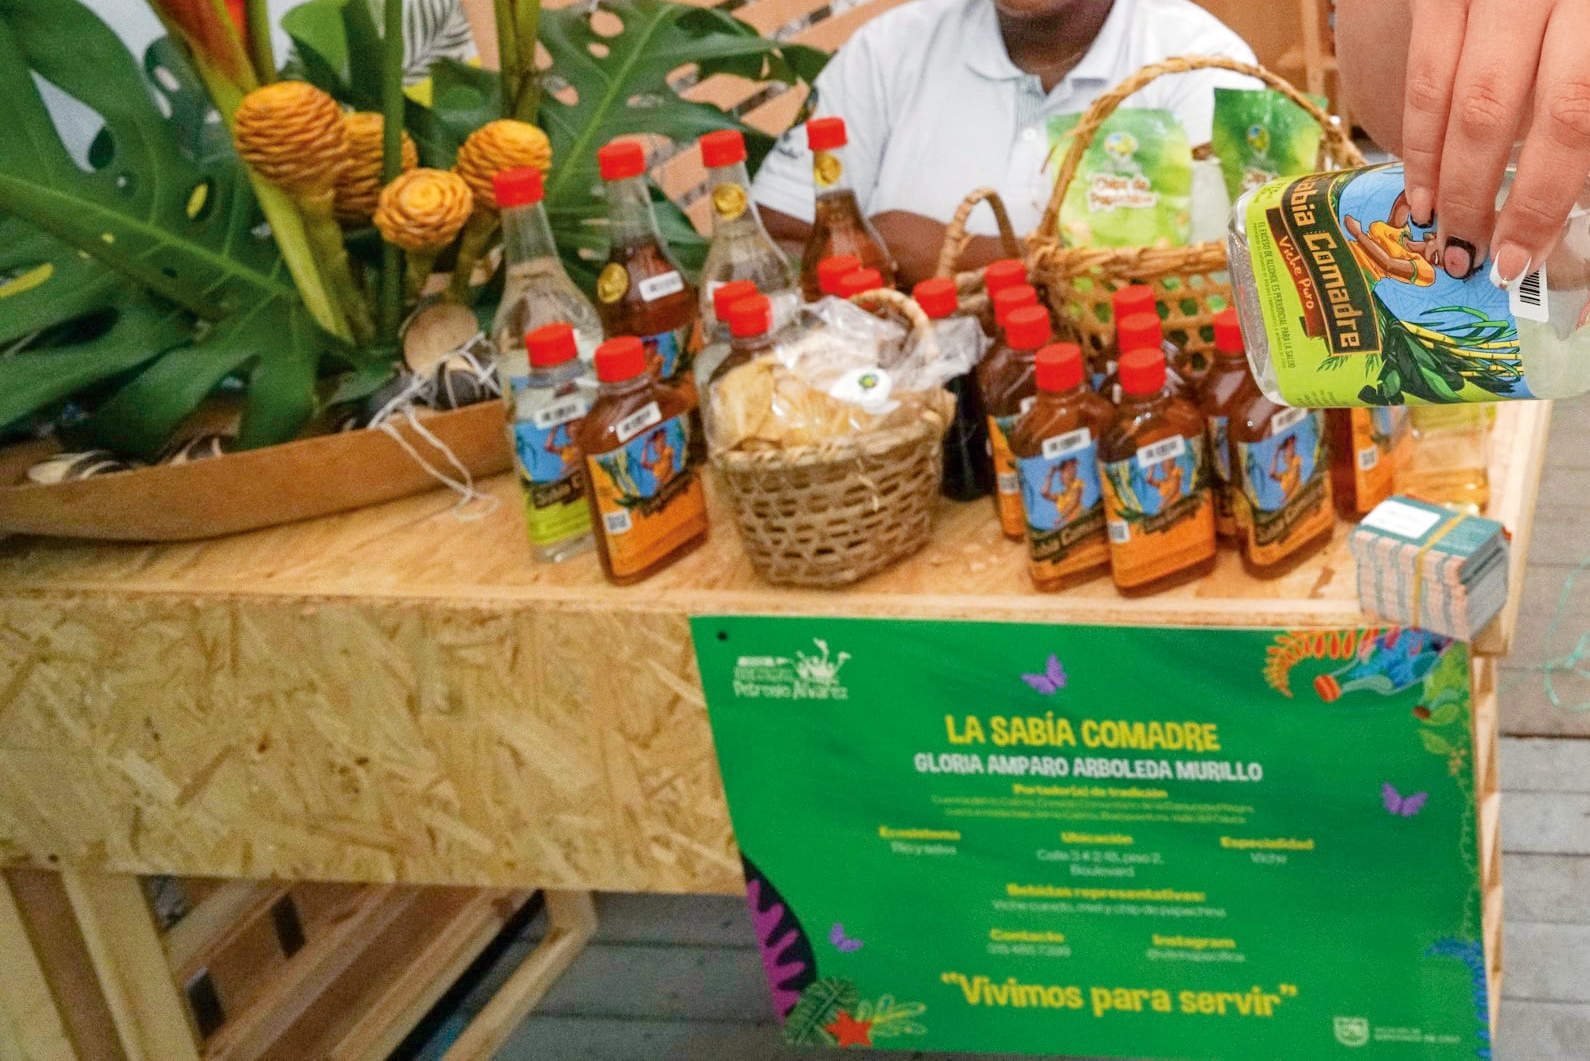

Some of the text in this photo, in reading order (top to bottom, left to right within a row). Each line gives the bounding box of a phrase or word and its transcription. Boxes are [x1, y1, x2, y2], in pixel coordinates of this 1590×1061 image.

[1279, 235, 1315, 310] Viche Puro
[1303, 231, 1362, 348] Comadre
[945, 710, 1221, 752] LA SABÍA COMADRE
[914, 752, 1264, 782] GLORIA AMPARO ARBOLEDA MURILLO
[1092, 984, 1172, 1018] para
